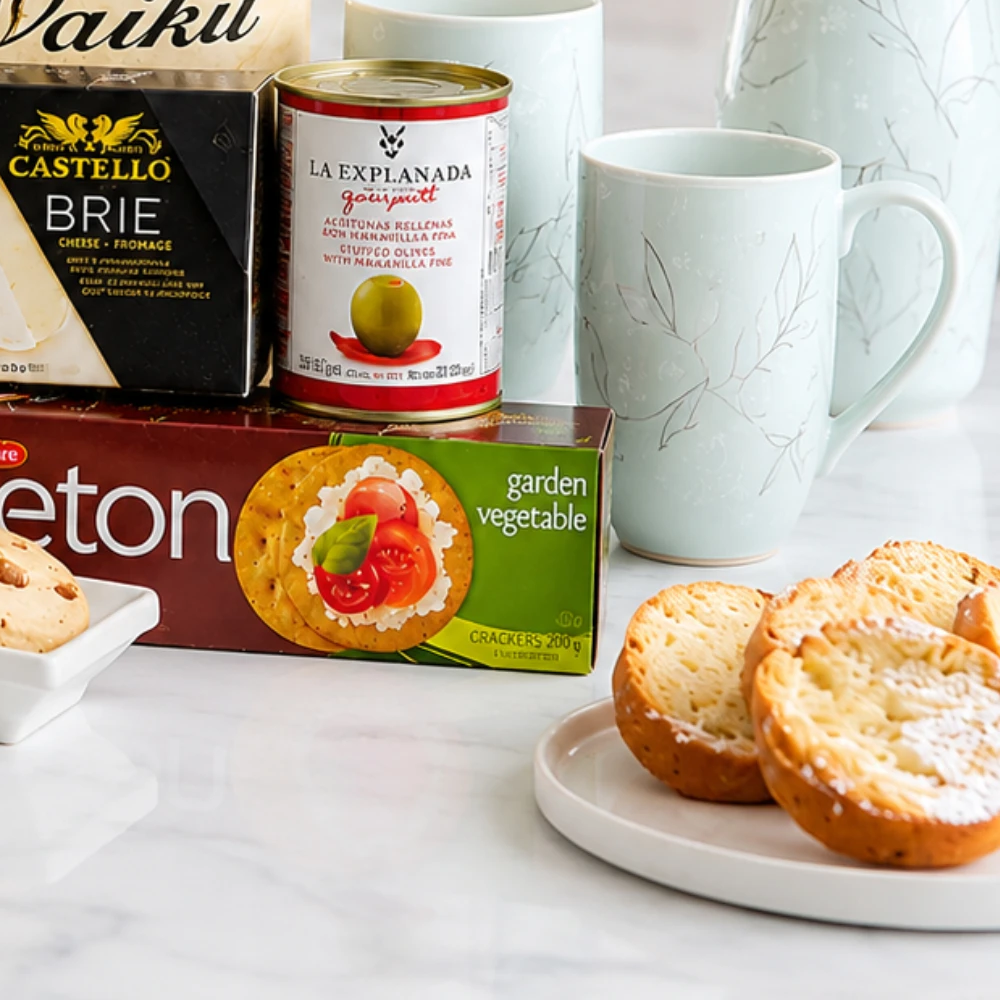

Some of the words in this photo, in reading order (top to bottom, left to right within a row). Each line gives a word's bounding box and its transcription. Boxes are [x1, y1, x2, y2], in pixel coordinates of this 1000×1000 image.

[8, 155, 171, 180] CASTELLO
[310, 160, 333, 178] LA
[339, 164, 473, 183] EXPLANADA
[46, 194, 161, 235] BRIE
[114, 239, 173, 251] FROMAGE
[507, 466, 587, 501] garden
[476, 502, 587, 536] vegetable
[470, 630, 543, 649] CRACKERS
[546, 632, 571, 650] 200
